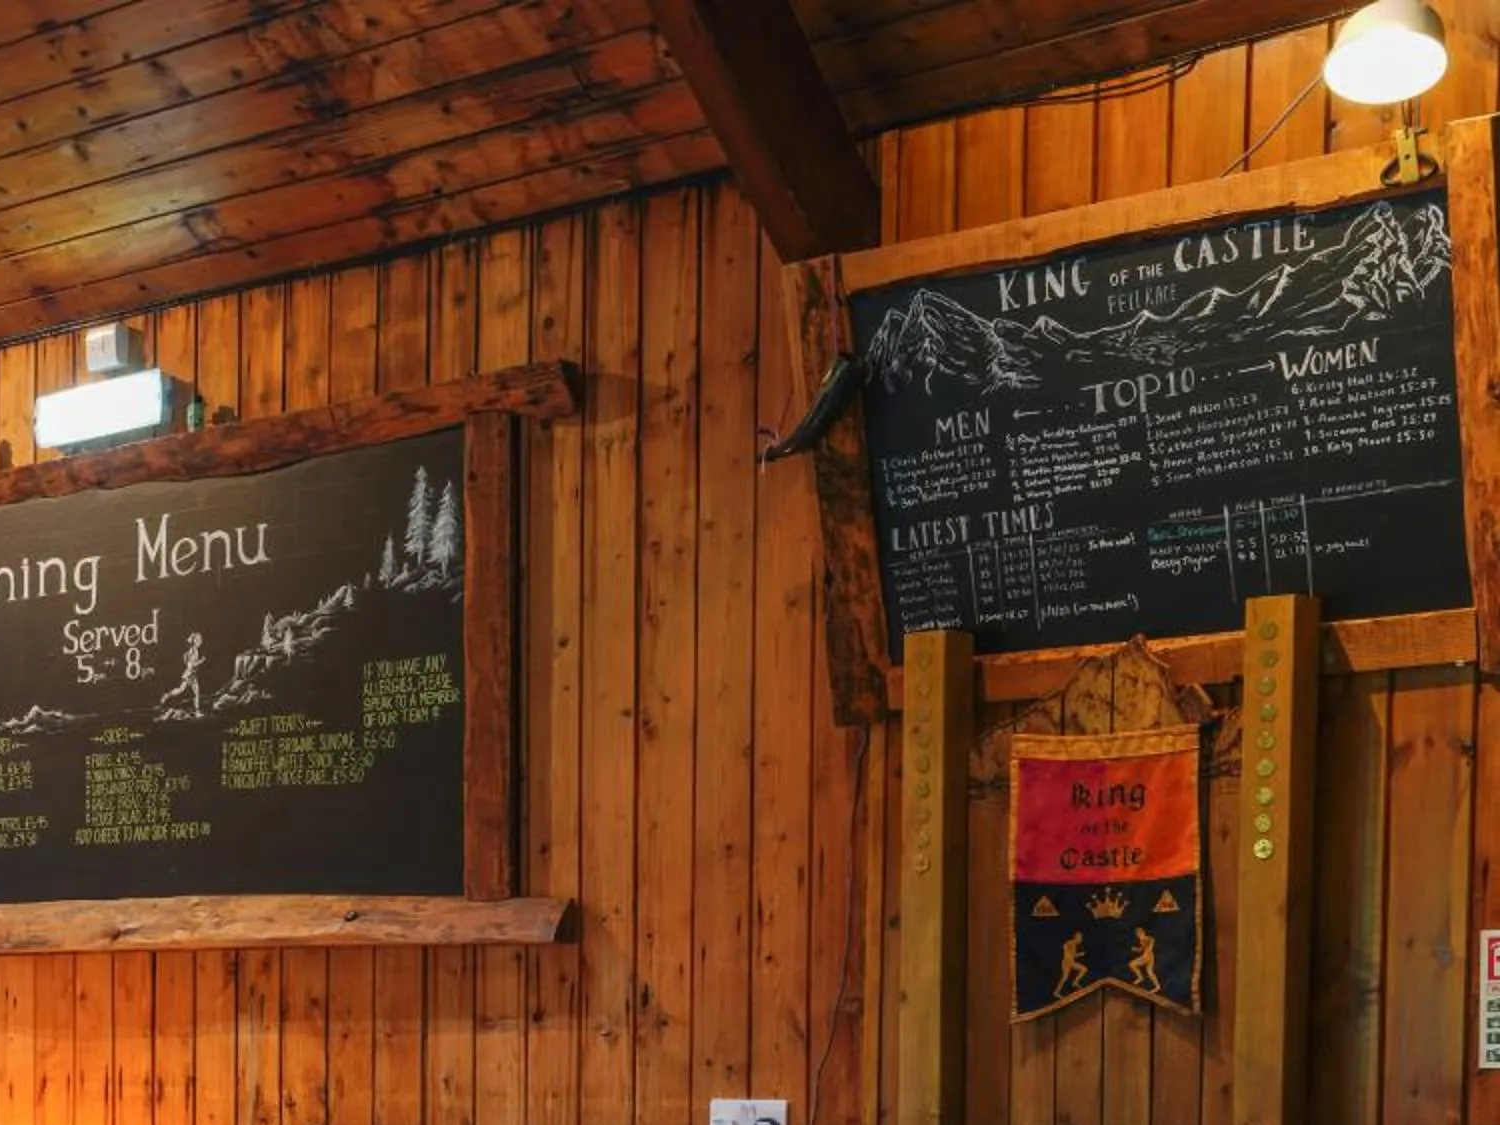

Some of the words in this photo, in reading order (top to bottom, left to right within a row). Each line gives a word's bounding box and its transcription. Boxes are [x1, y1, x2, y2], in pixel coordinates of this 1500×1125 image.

[996, 257, 1092, 313] KING
[1109, 269, 1129, 287] OF
[1137, 263, 1164, 281] THE
[1172, 214, 1316, 273] CASTLE
[1276, 337, 1381, 382] WOMEN
[934, 407, 990, 446] MEN
[134, 513, 272, 583] Menu
[891, 514, 970, 552] LATEST
[982, 500, 1054, 538] TIMES
[62, 608, 161, 655] Served
[1071, 782, 1147, 812] King
[1058, 845, 1145, 872] Castle
